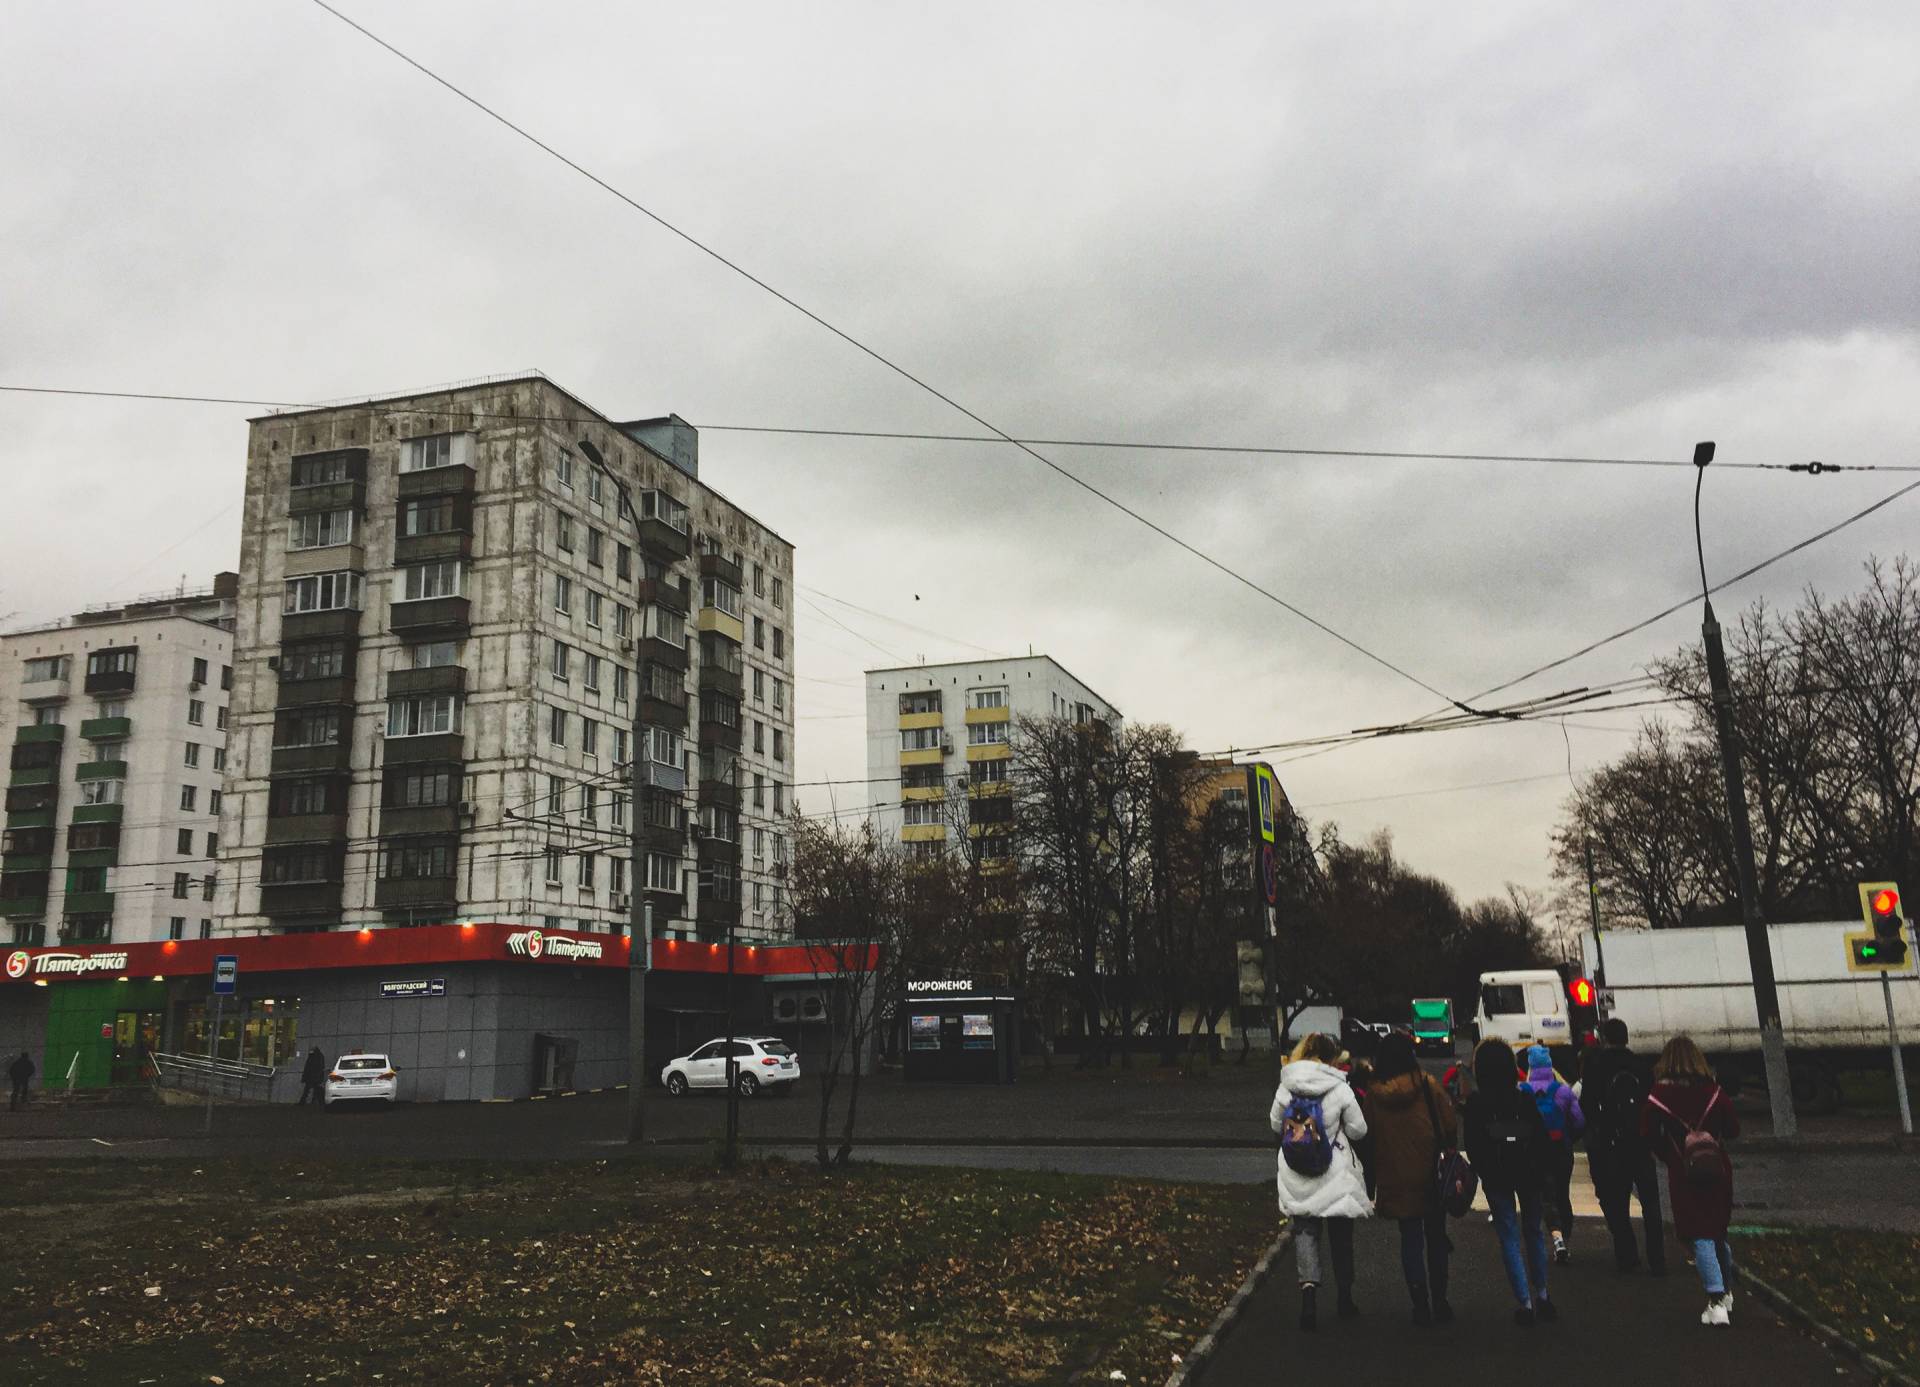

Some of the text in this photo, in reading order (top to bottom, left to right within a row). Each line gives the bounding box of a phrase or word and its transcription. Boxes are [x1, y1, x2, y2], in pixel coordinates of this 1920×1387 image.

[542, 936, 602, 960] Пятерочка
[32, 953, 127, 975] Пятерочка
[907, 980, 973, 991] МОРОЖЕНОЕ
